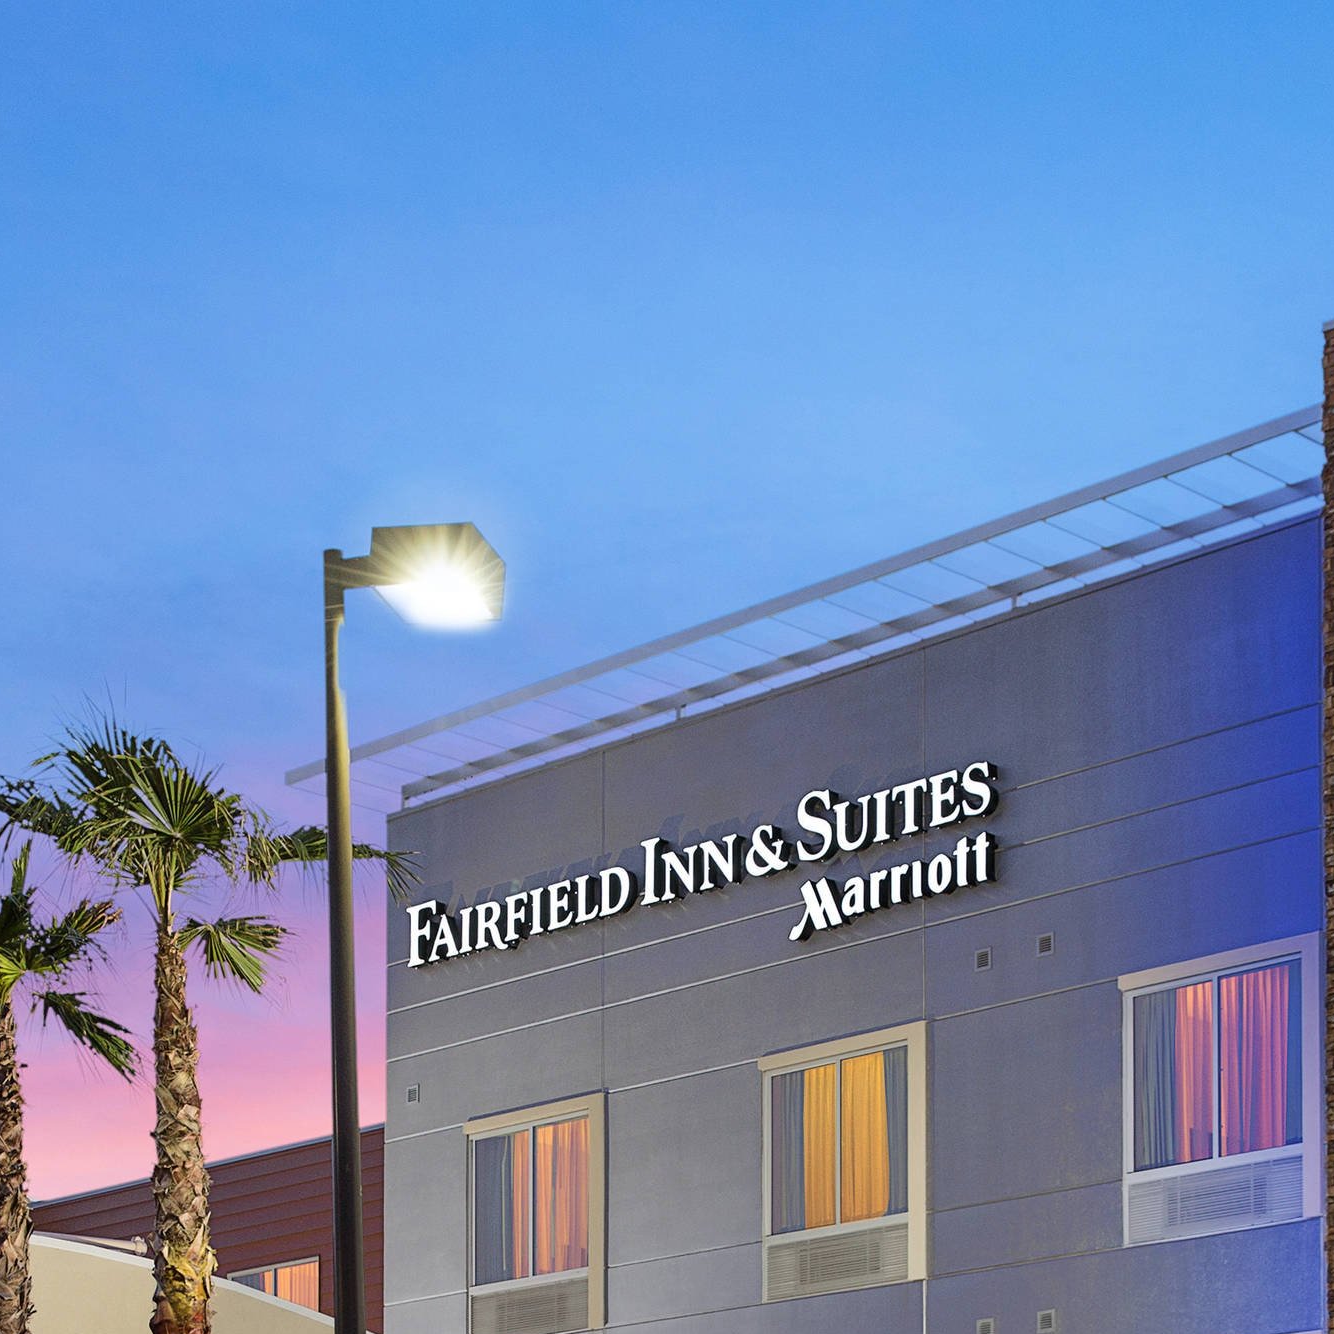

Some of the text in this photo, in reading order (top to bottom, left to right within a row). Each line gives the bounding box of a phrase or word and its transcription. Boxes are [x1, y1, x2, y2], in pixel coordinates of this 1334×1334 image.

[406, 761, 995, 968] FAIRFIELD INN & SUITES
[787, 832, 995, 943] Marriott
